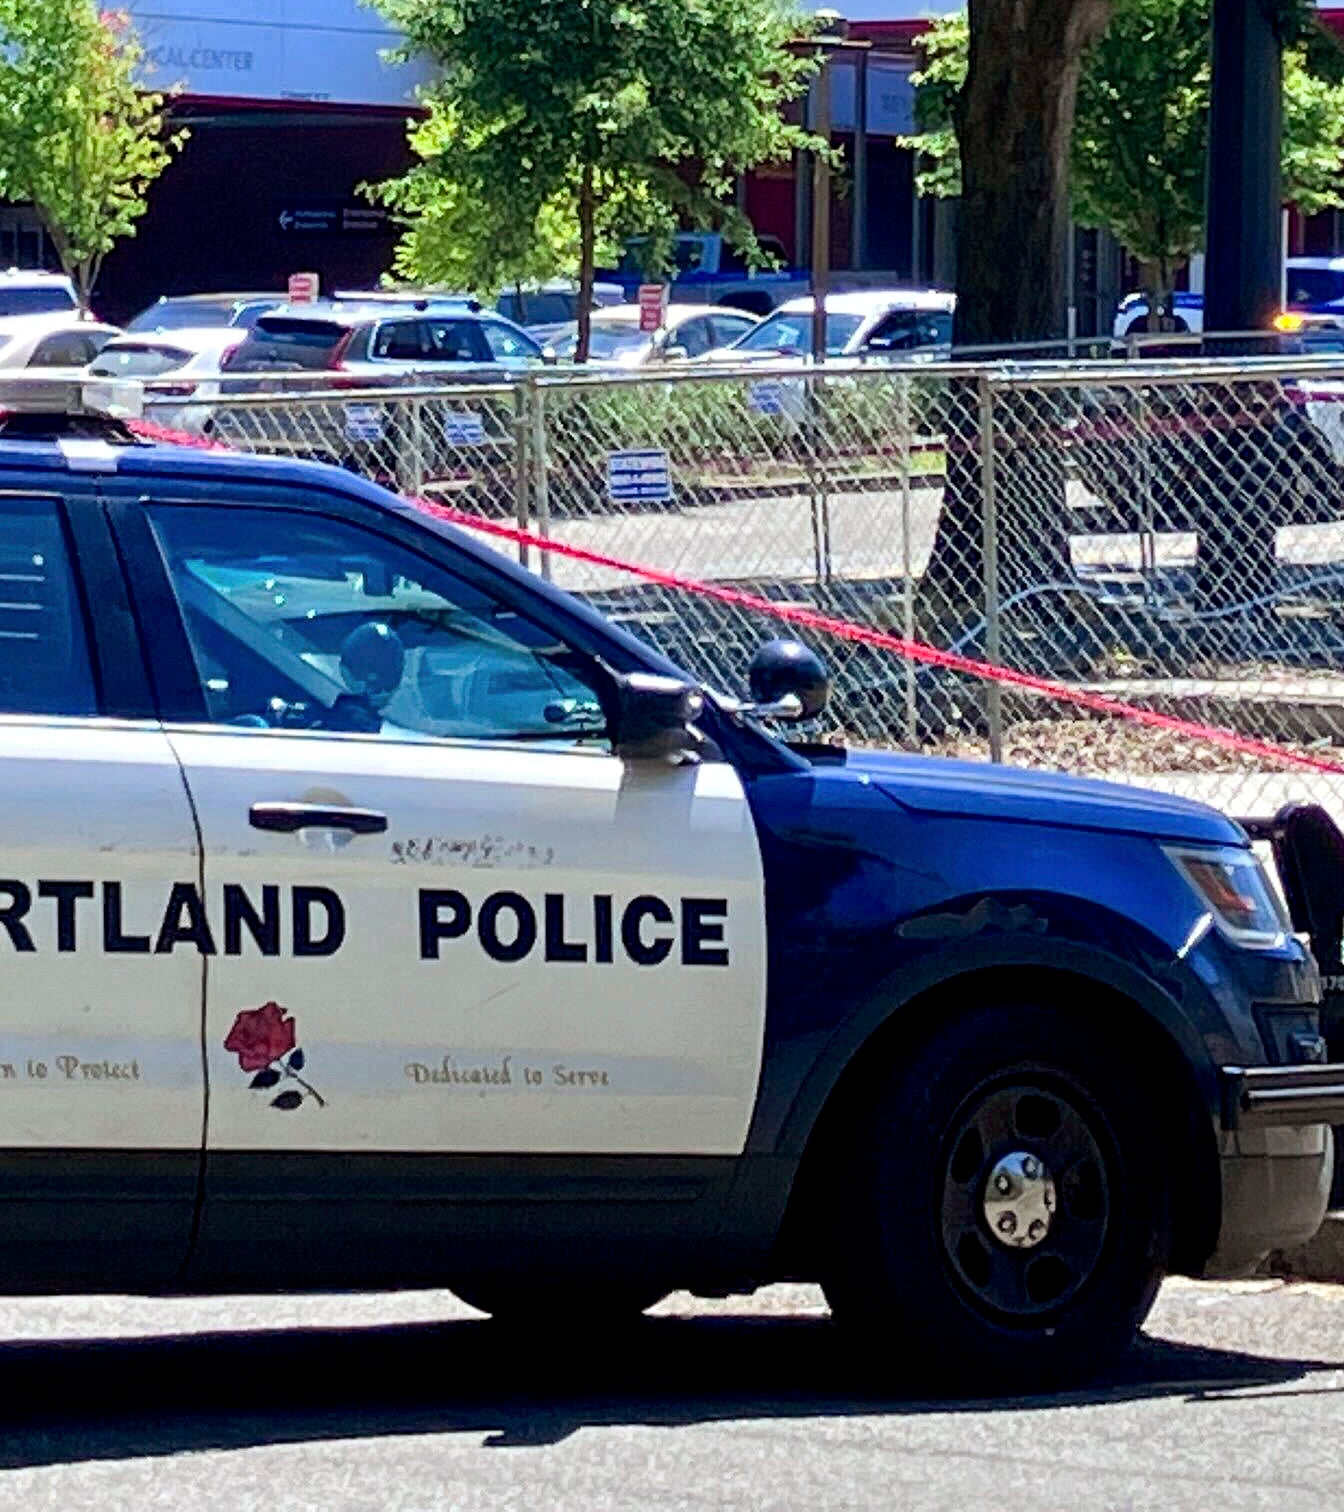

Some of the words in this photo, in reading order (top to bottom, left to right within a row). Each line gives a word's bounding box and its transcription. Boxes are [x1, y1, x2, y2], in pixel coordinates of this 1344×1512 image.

[190, 49, 253, 71] CENTER
[419, 890, 730, 968] POLICE
[27, 1058, 48, 1080] to
[56, 1055, 140, 1080] Protect
[404, 1055, 511, 1086] Dedicated
[524, 1066, 543, 1085] to
[552, 1063, 609, 1087] Serve
